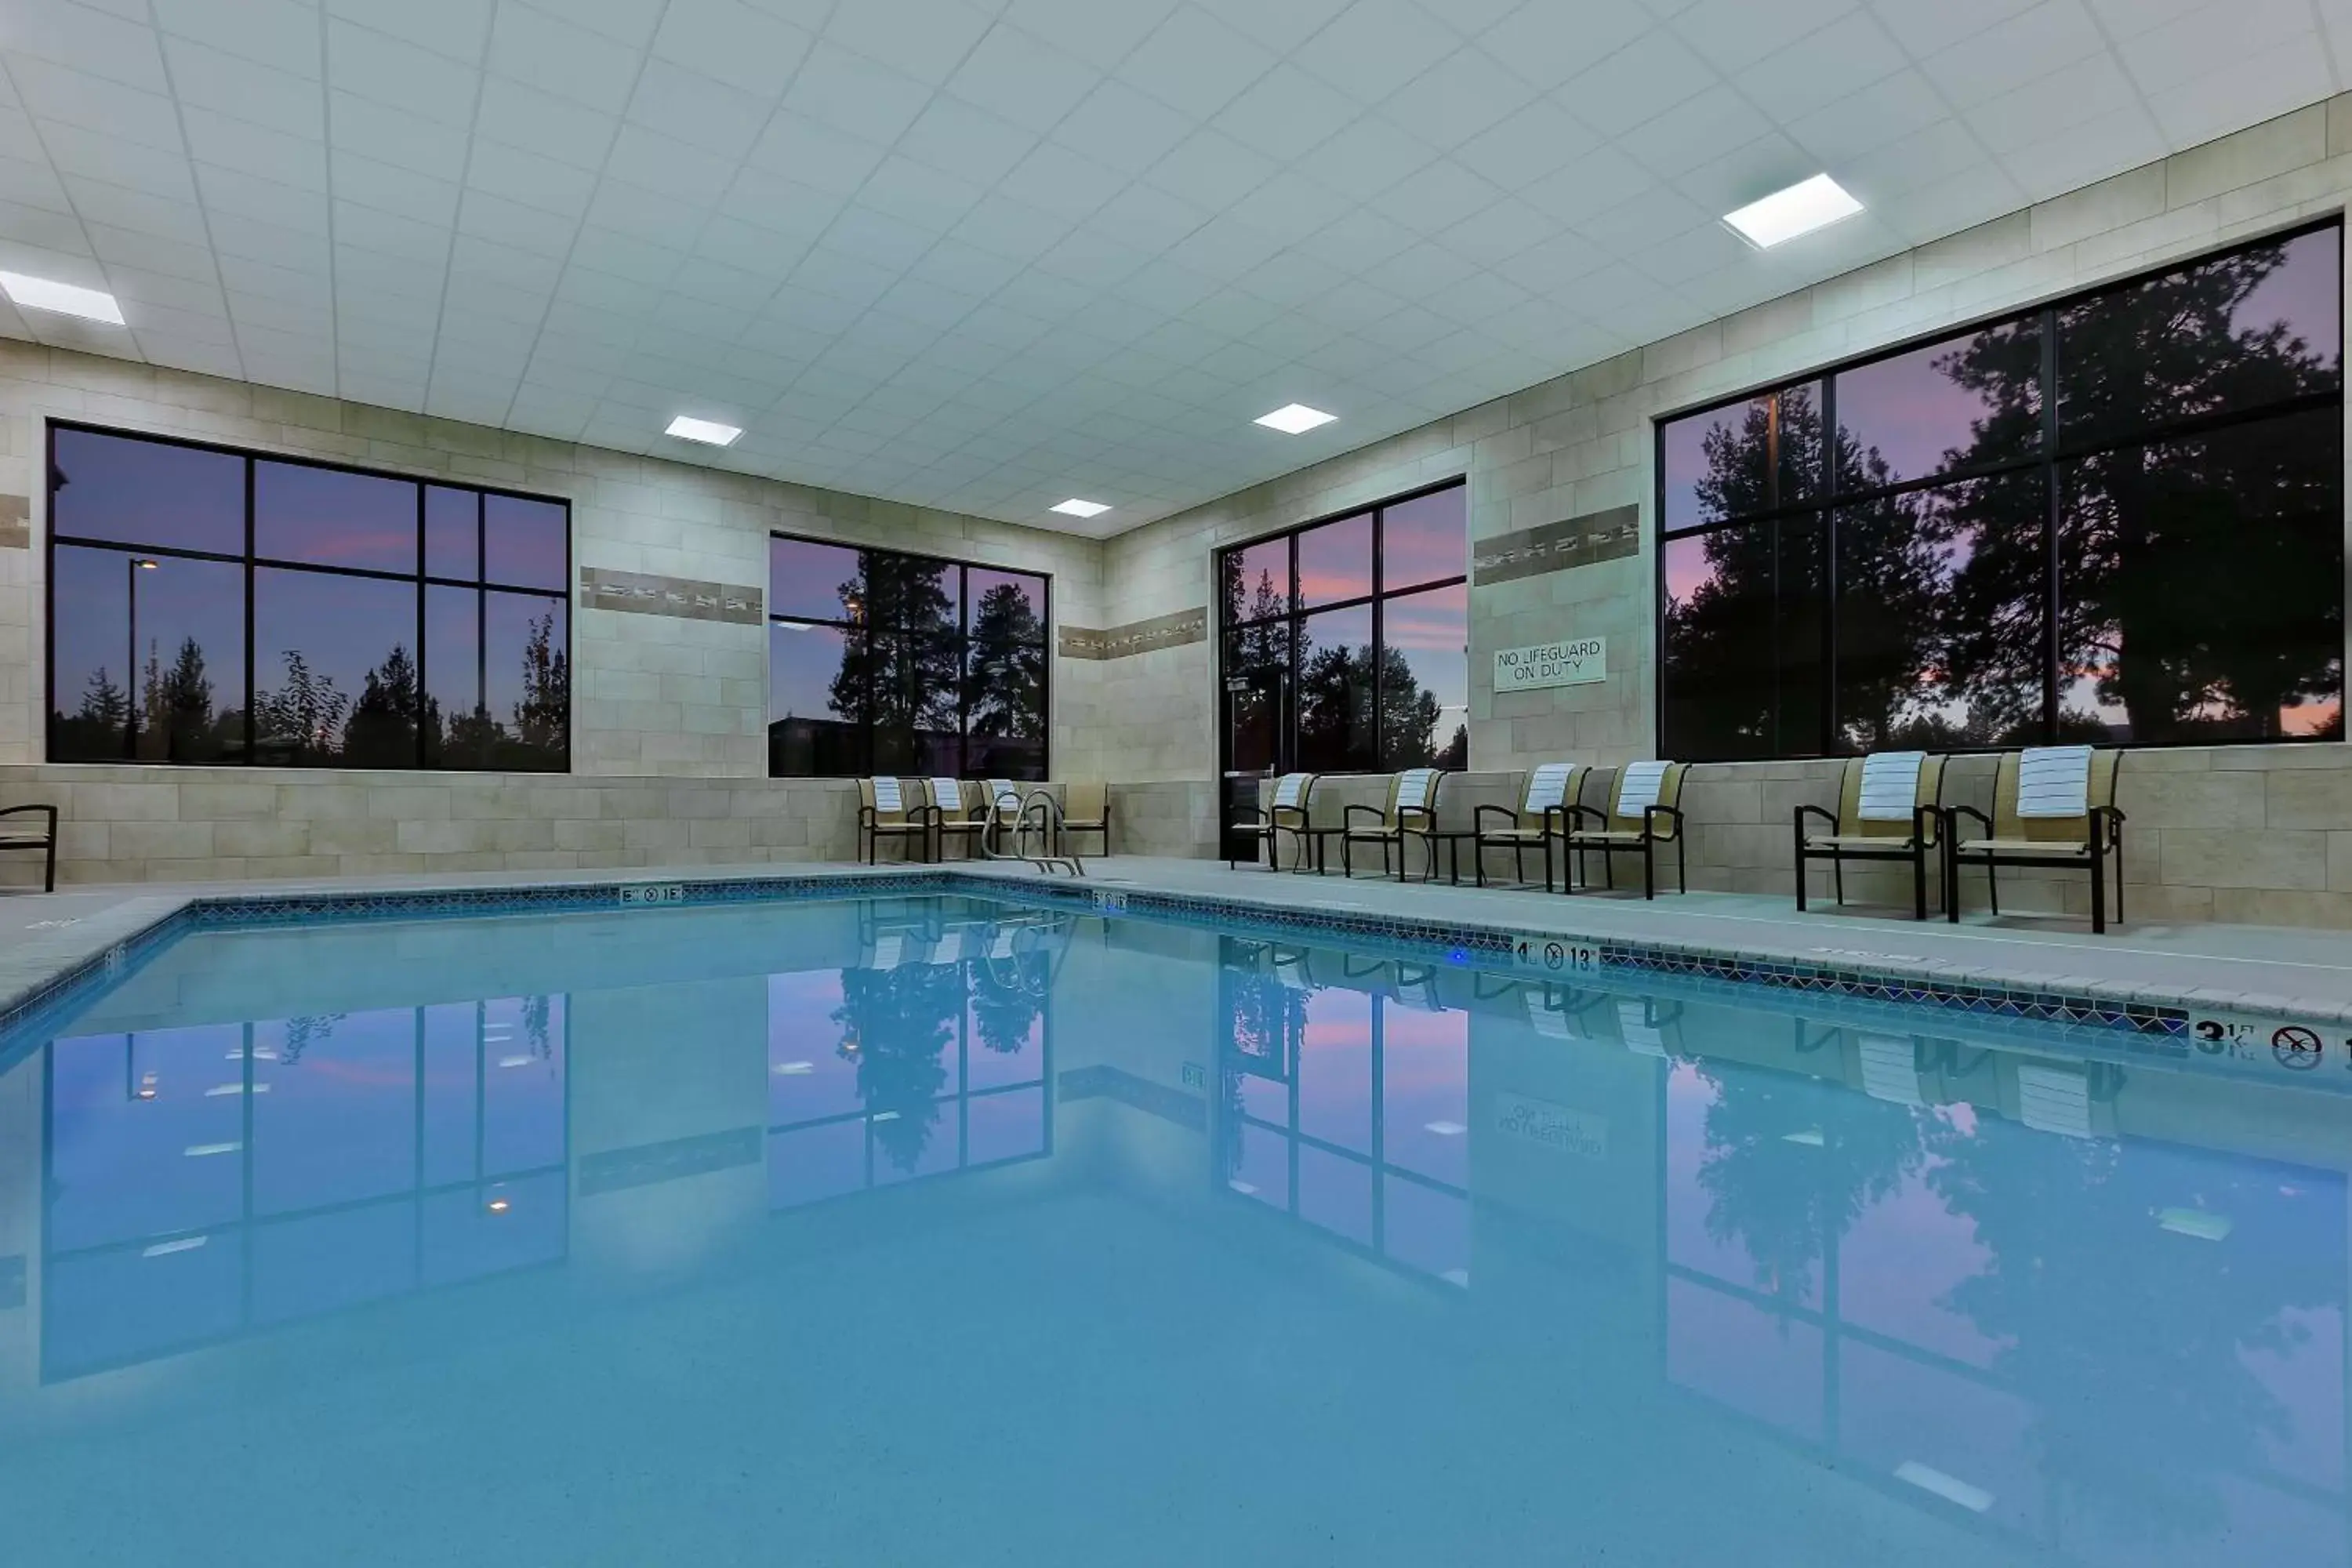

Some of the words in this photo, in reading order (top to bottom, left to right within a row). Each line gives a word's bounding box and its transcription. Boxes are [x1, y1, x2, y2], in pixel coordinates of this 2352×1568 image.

[1498, 652, 1519, 667] NO
[1523, 641, 1601, 664] LIFEGUARD
[1514, 666, 1534, 681] ON
[1541, 659, 1583, 676] DUTY
